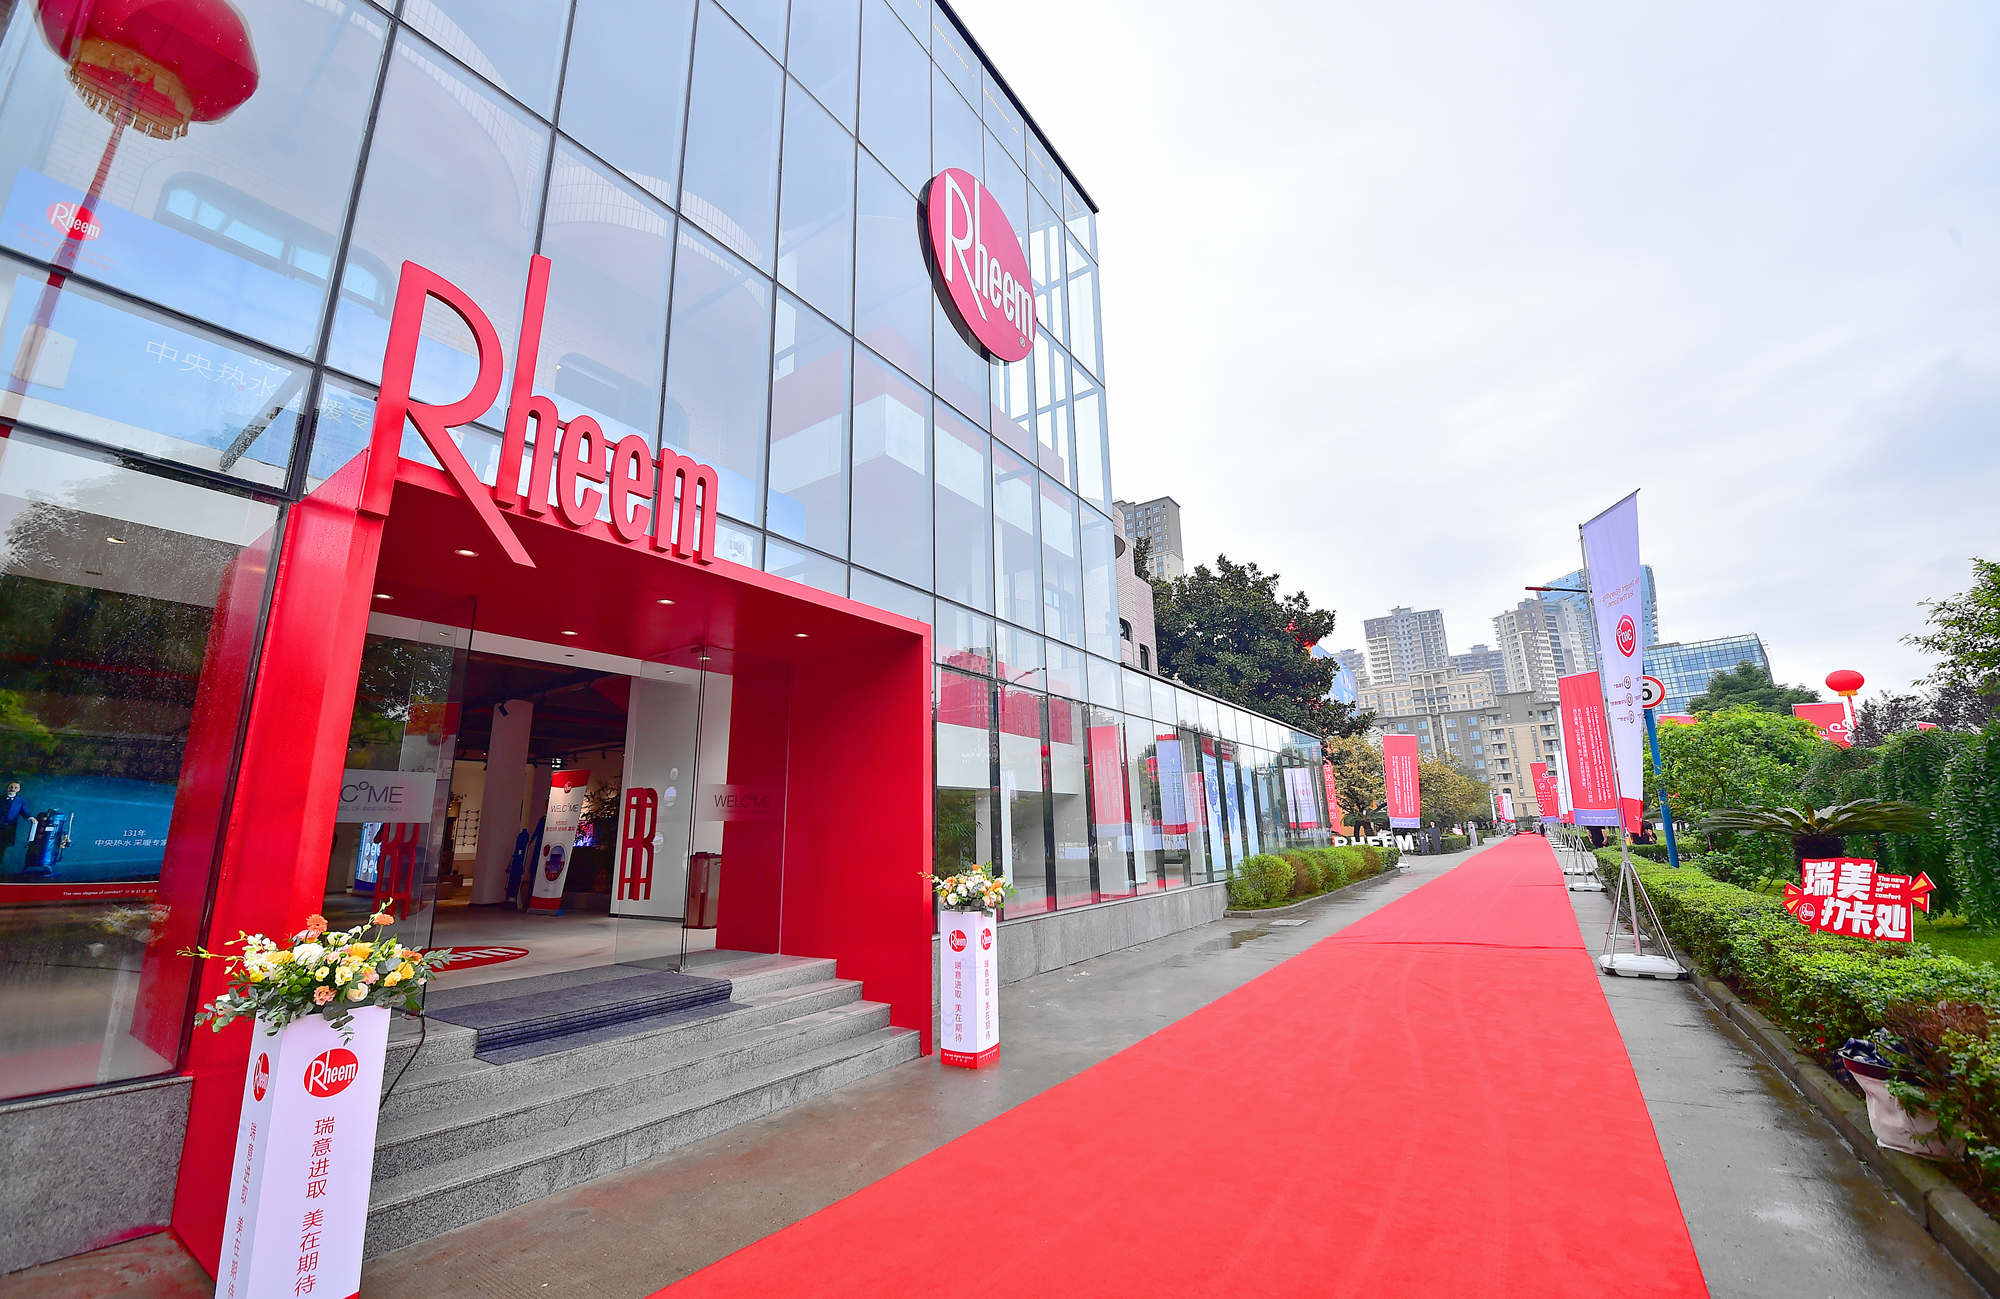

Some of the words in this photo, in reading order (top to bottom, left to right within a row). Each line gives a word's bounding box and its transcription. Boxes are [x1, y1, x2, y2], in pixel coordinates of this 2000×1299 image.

[50, 203, 101, 239] Rheem
[944, 171, 1035, 344] Rheem
[357, 253, 719, 568] Rheem
[1803, 861, 1873, 900] 瑞美
[1820, 897, 1907, 939] 打卡处
[308, 1051, 357, 1093] Rheem
[305, 1115, 336, 1200] 瑞意进取
[294, 1207, 325, 1298] 美在期待
